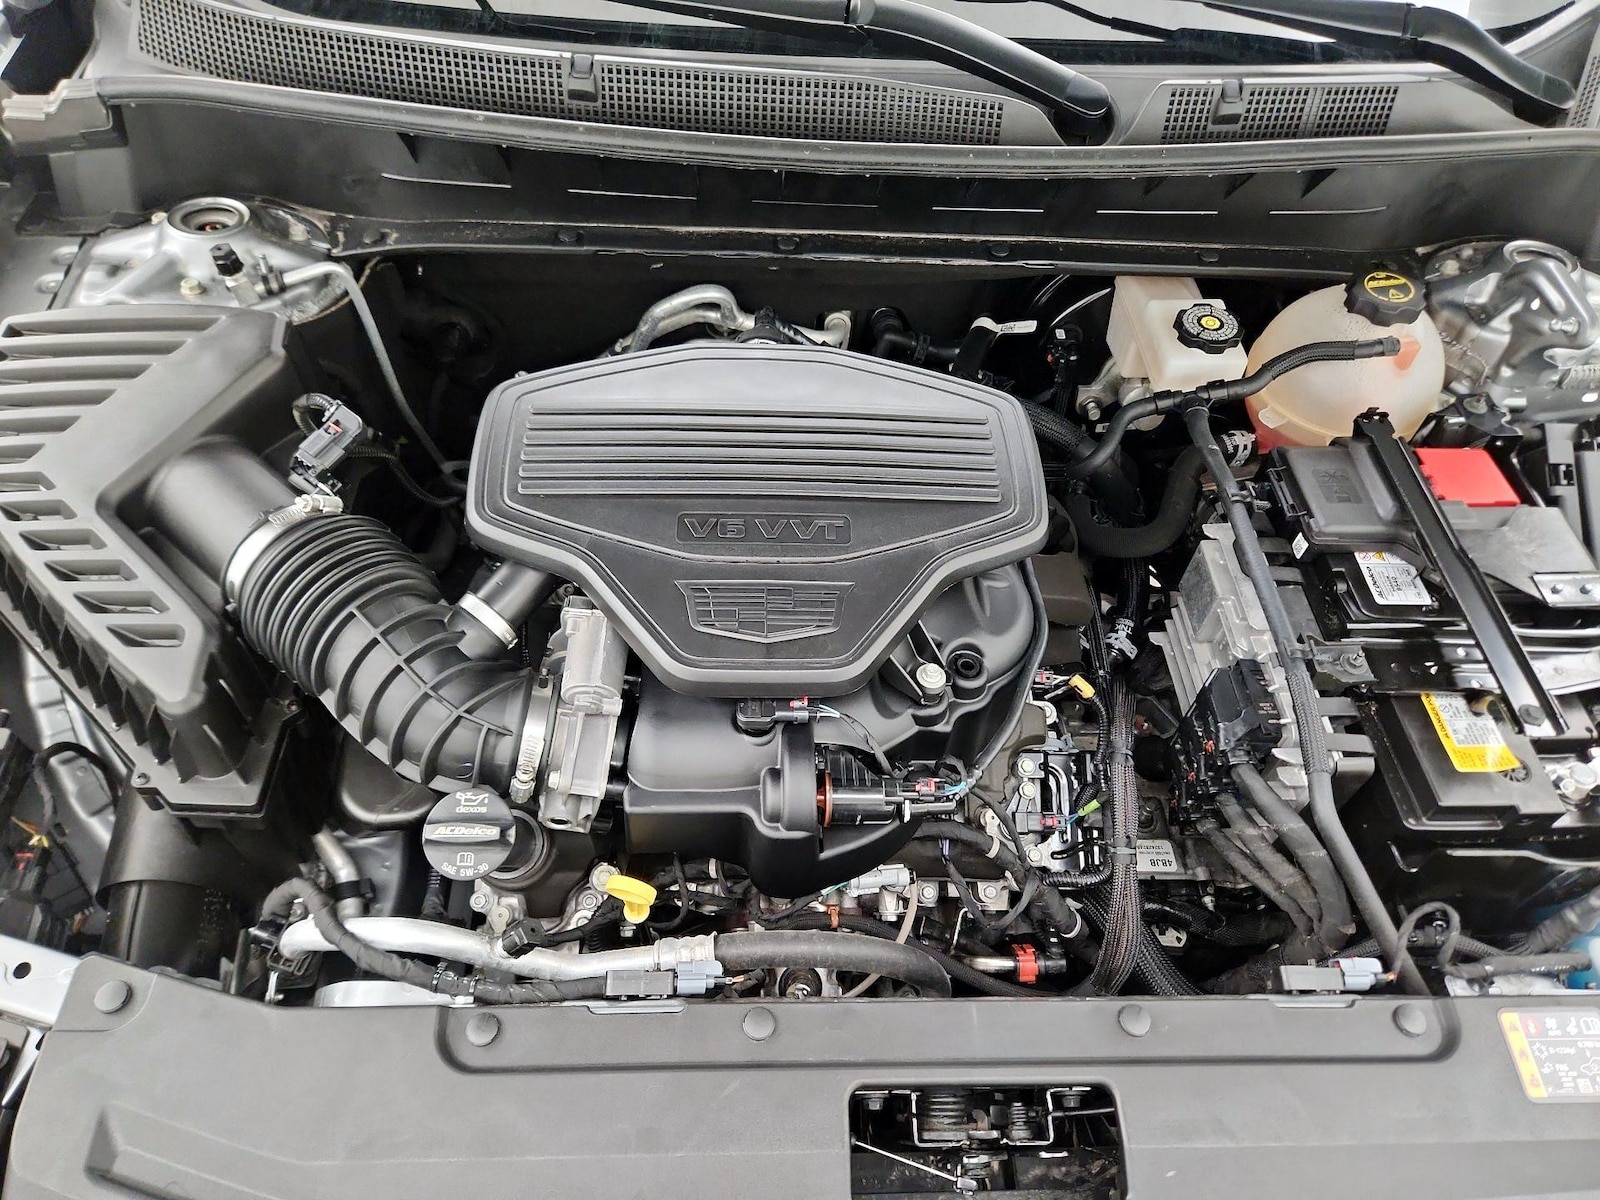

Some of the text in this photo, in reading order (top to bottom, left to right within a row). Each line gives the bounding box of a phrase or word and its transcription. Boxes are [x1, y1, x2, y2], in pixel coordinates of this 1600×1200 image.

[684, 518, 845, 540] V6 VVT
[455, 805, 488, 813] dexos
[433, 826, 498, 836] ACDelco
[441, 861, 489, 877] SAE 5W-30
